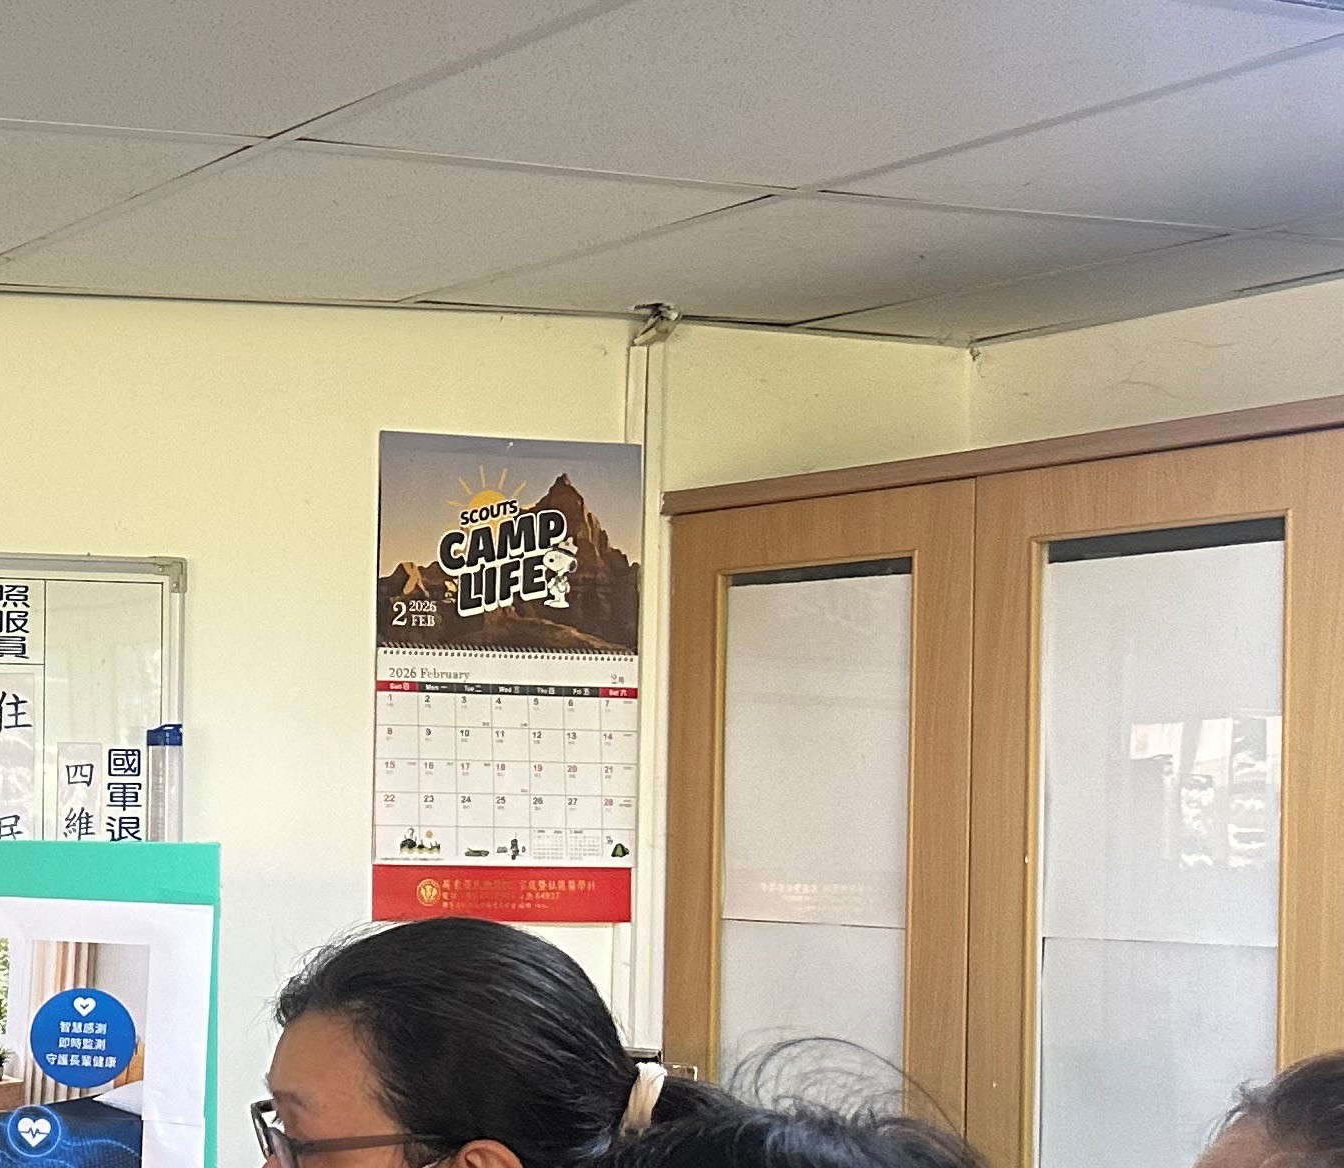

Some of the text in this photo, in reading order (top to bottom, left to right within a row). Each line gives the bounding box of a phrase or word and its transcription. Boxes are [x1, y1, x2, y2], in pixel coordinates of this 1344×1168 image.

[461, 500, 518, 525] SCOUTS
[439, 511, 565, 570] CAMP
[459, 555, 545, 611] LIFE
[392, 601, 437, 626] 2 2026
[411, 615, 435, 626] FEB
[389, 668, 470, 682] 2026 February
[59, 1021, 107, 1034] 智慧感測
[58, 1037, 106, 1050] 即時監測
